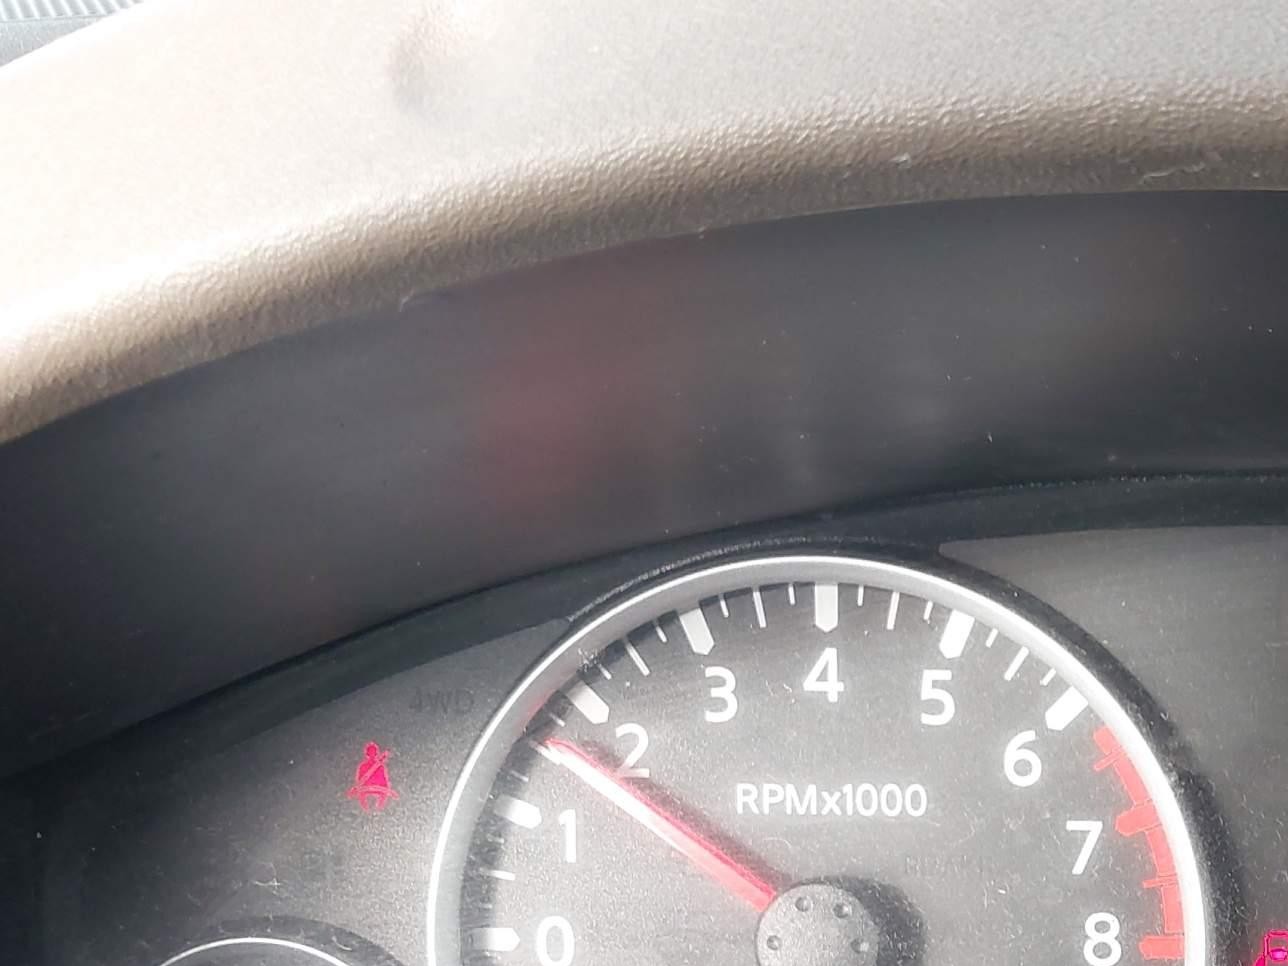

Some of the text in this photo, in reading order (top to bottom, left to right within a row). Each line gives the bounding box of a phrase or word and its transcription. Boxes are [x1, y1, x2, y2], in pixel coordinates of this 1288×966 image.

[705, 667, 737, 722] 3
[803, 648, 844, 702] 4
[921, 670, 955, 725] 5
[615, 722, 650, 778] 2
[1004, 730, 1041, 787] 6
[736, 783, 926, 816] RPMx1000
[558, 809, 578, 863] 1
[1066, 821, 1102, 874] 7
